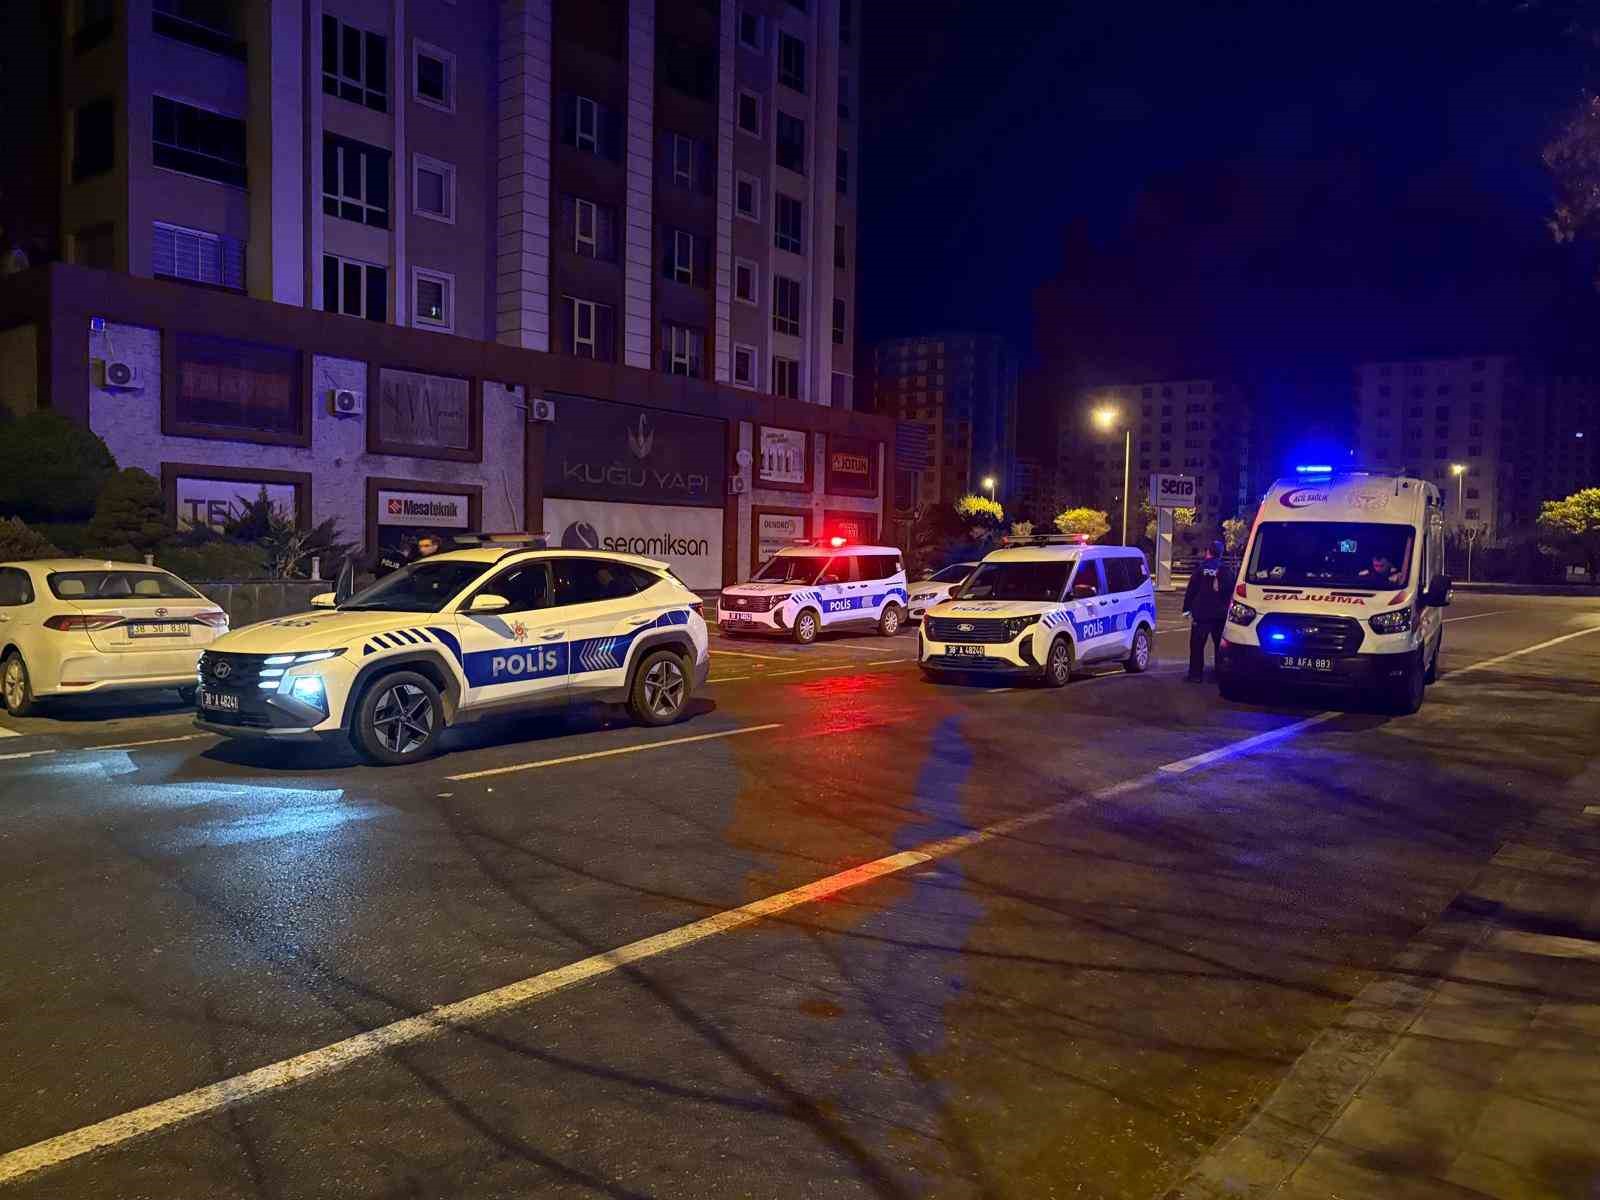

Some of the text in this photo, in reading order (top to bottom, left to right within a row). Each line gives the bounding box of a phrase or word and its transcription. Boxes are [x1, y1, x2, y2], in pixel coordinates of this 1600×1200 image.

[562, 459, 709, 494] KUĞU YAPI
[1161, 479, 1193, 495] serra
[403, 500, 457, 516] Mesateknik
[603, 532, 708, 556] seramiksan
[1083, 618, 1104, 639] POLİS
[492, 646, 558, 678] POLİS
